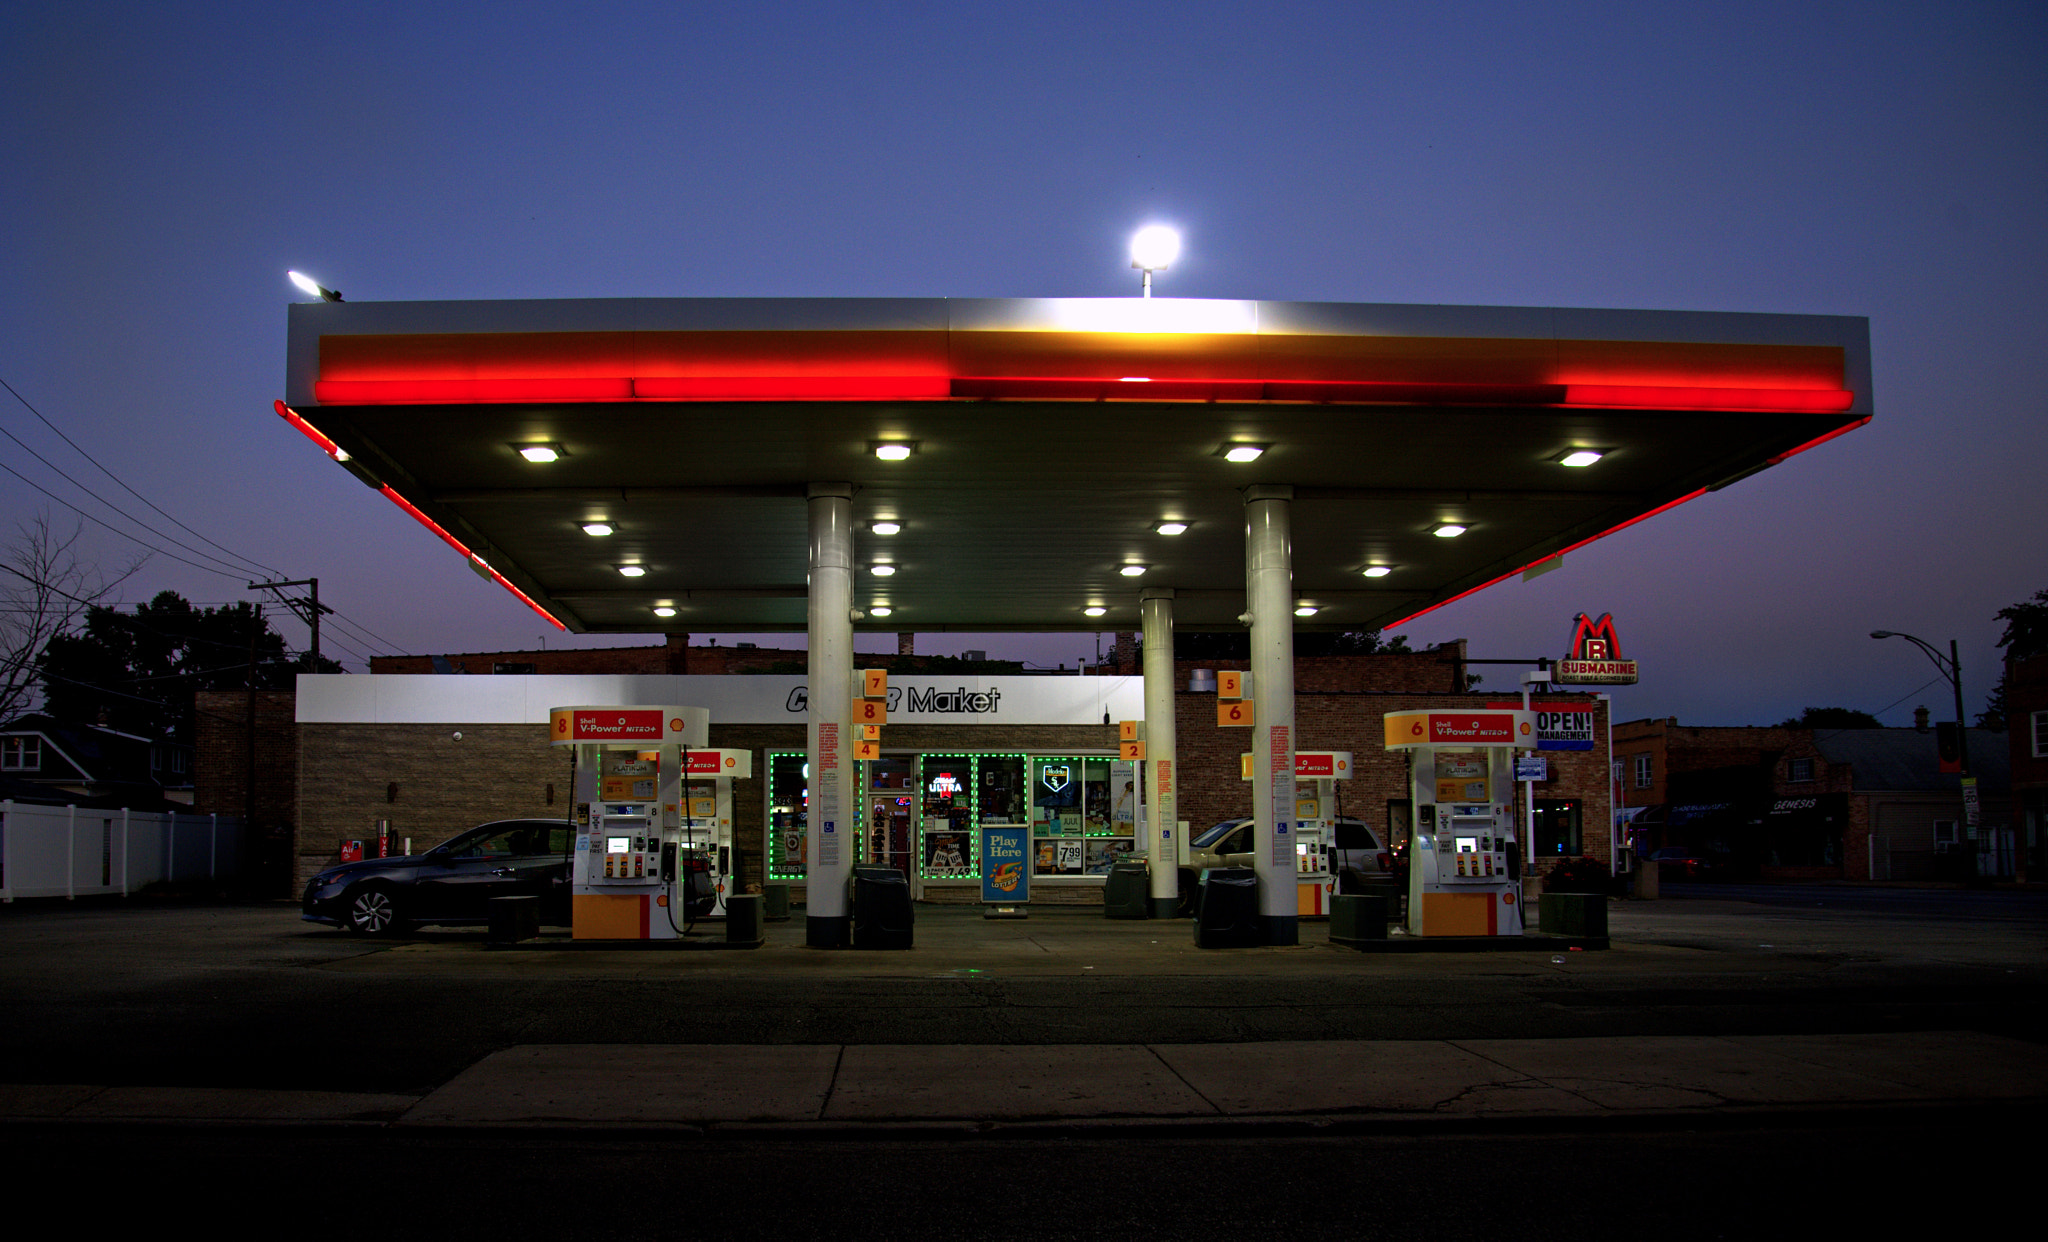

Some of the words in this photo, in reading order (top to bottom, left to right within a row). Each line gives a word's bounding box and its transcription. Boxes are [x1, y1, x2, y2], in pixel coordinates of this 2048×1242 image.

[1561, 662, 1635, 674] SUBMARINE
[872, 678, 881, 688] 7
[1226, 679, 1235, 690] 5
[907, 686, 1001, 713] Market
[864, 704, 875, 719] 8
[1229, 706, 1242, 720] 6
[558, 718, 567, 733] 8
[1537, 712, 1591, 731] OPEN!
[580, 725, 622, 733] V-Power
[1411, 721, 1424, 736] 6
[1436, 728, 1476, 736] V-Power
[1537, 731, 1591, 740] MANAGEMENT
[862, 744, 870, 755] 4
[1130, 746, 1138, 756] 2
[929, 783, 963, 793] ULTRA
[1773, 798, 1817, 810] GENESIS
[1965, 794, 1977, 803] 20
[651, 807, 657, 816] 8
[1495, 807, 1501, 815] 6
[990, 835, 1018, 848] Play
[990, 847, 1022, 857] Here
[773, 865, 801, 874] ENERGY
[991, 872, 1023, 888] LOTTERY
